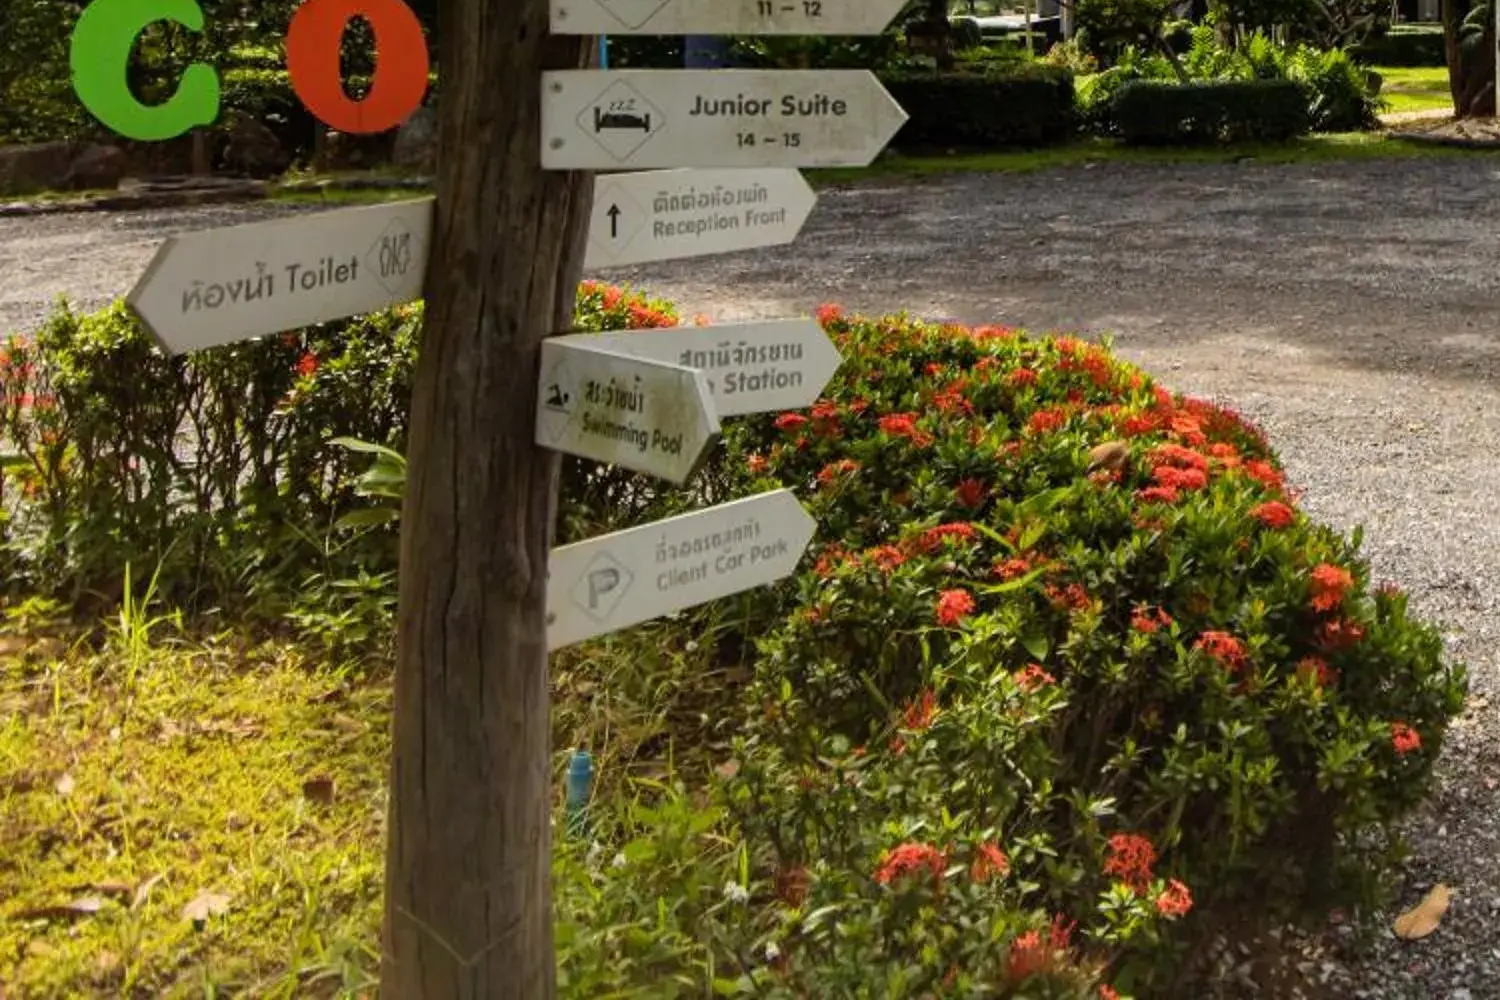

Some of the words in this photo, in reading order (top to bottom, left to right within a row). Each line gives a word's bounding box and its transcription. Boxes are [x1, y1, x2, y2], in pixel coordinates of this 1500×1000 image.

[757, 0, 773, 16] 11
[803, 0, 822, 17] 12
[689, 94, 771, 116] Junior
[780, 94, 847, 116] Suite
[736, 132, 755, 148] 14
[784, 132, 801, 147] 15
[653, 213, 740, 239] Reception
[745, 207, 785, 227] Front
[285, 255, 358, 292] Toilet
[724, 368, 802, 394] Station
[582, 411, 648, 454] Swimming
[651, 429, 683, 456] Pool
[656, 561, 708, 592] Client
[715, 553, 745, 574] Car
[750, 537, 788, 565] Park
